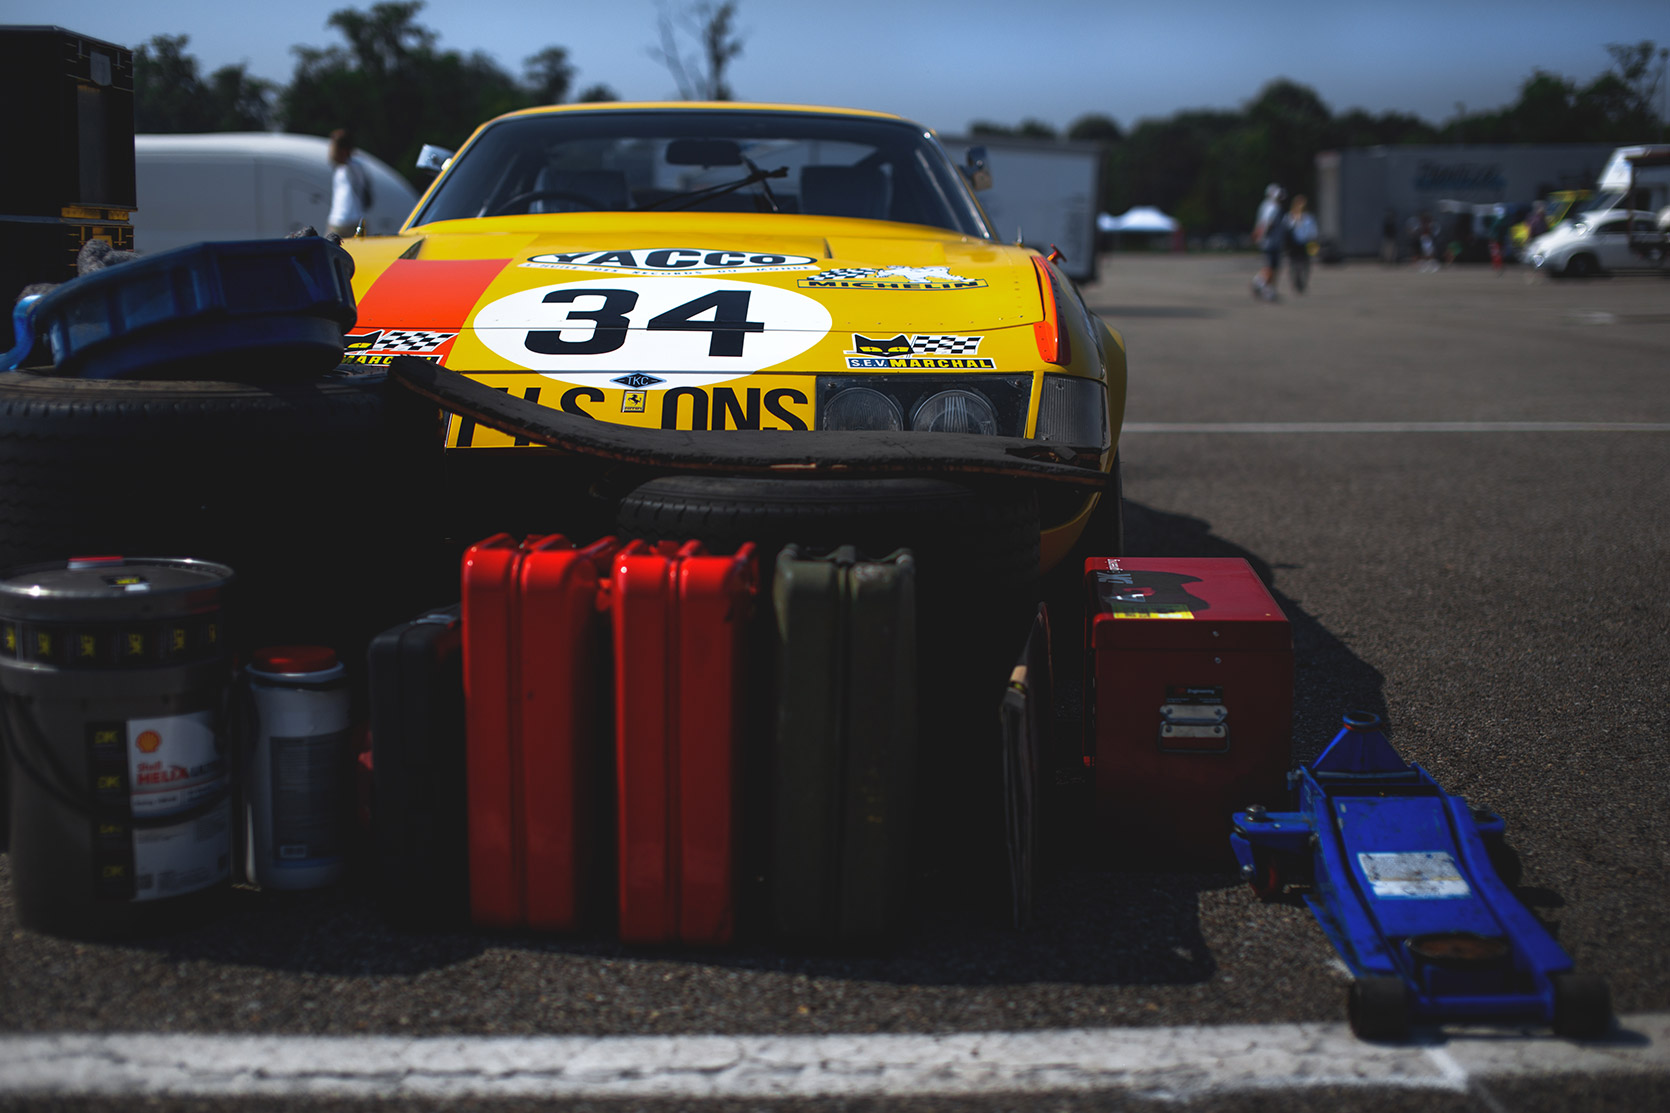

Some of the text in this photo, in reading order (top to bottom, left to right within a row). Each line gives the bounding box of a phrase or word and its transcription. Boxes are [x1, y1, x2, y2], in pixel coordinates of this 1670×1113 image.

[553, 250, 786, 268] YACCO
[808, 281, 978, 289] MICHELIN
[524, 288, 765, 357] 34
[851, 359, 992, 368] S.E.V. MARCHAL
[627, 376, 649, 386] TKC
